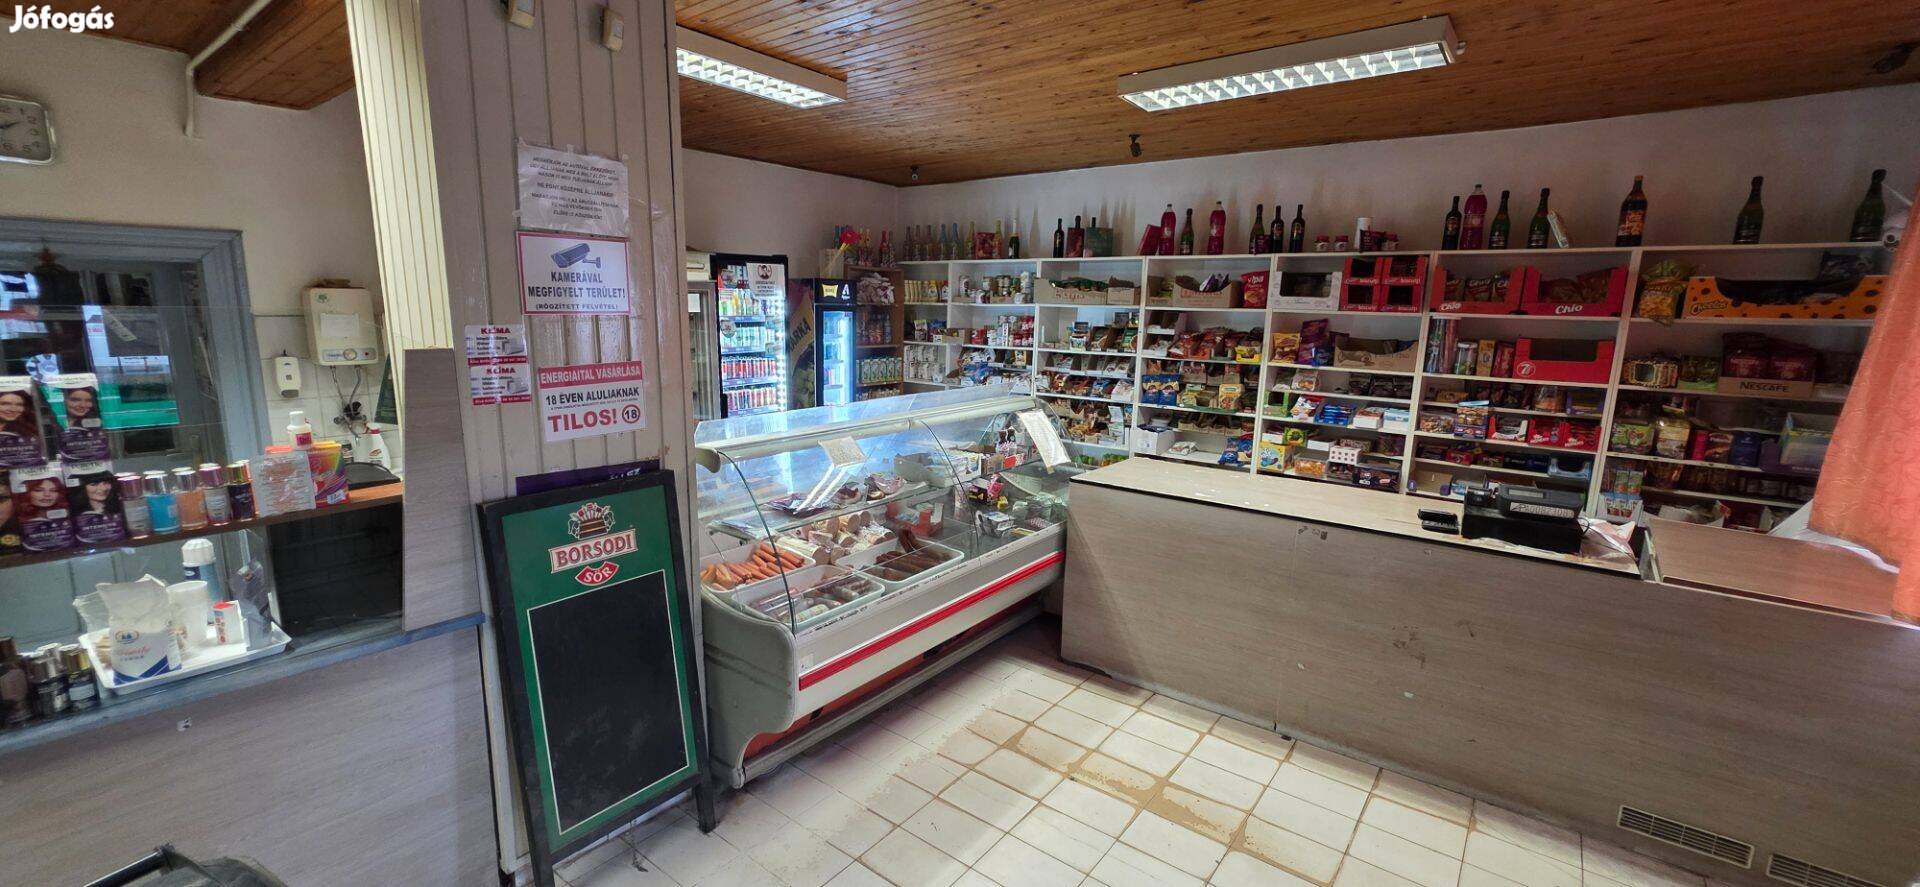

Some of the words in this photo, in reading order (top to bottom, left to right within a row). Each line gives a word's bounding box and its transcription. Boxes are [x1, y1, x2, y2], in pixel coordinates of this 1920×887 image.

[550, 270, 603, 284] KAMERÁVAL
[528, 285, 584, 298] MEGFIGYELT
[586, 286, 626, 299] TERÜLET!
[1439, 302, 1462, 311] Chio
[1555, 303, 1583, 315] Chio
[540, 368, 595, 384] ENERGIAITAL
[596, 366, 641, 381] VÁSÁRLÁSA
[545, 393, 557, 406] 18
[586, 386, 640, 401] ALULIAKNAK
[547, 408, 617, 433] TILOS!
[624, 408, 638, 420] 18
[555, 533, 634, 568] BORSODI
[583, 566, 613, 583] SÖR
